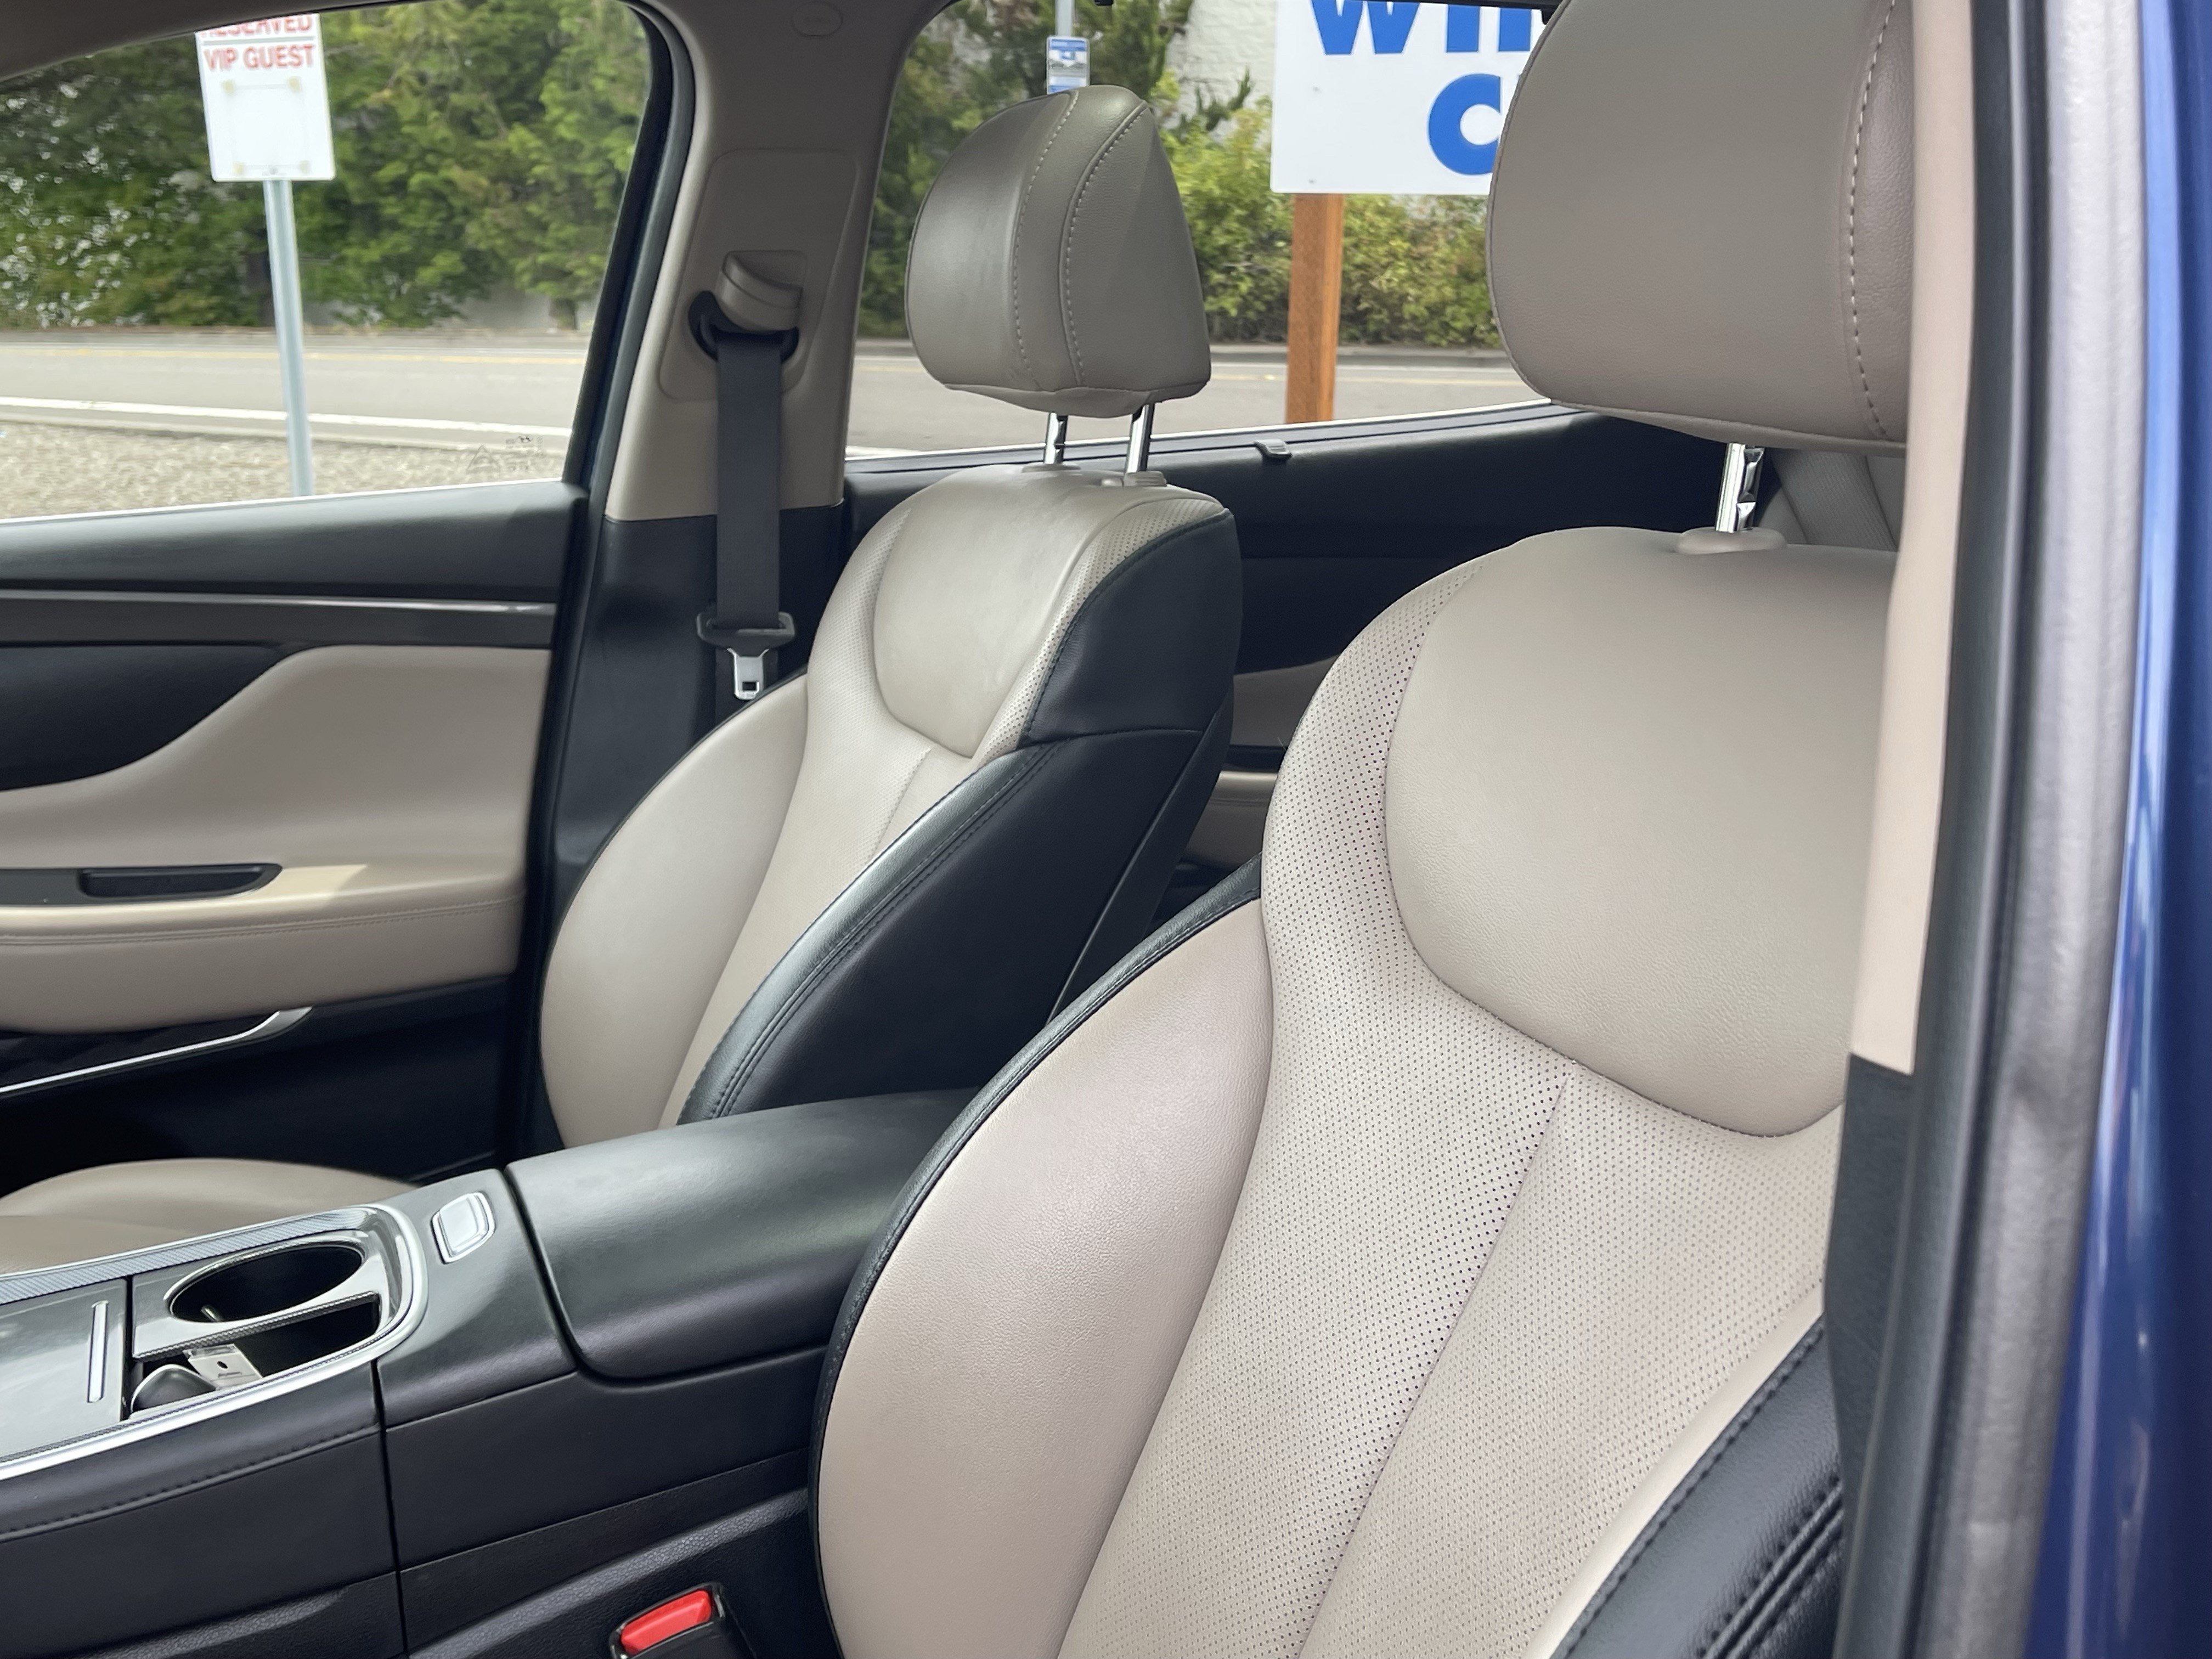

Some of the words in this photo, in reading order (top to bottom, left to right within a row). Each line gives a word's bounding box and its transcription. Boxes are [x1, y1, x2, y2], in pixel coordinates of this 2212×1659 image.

[201, 16, 313, 37] ERVED
[204, 48, 236, 70] VIP
[244, 44, 315, 70] GUEST
